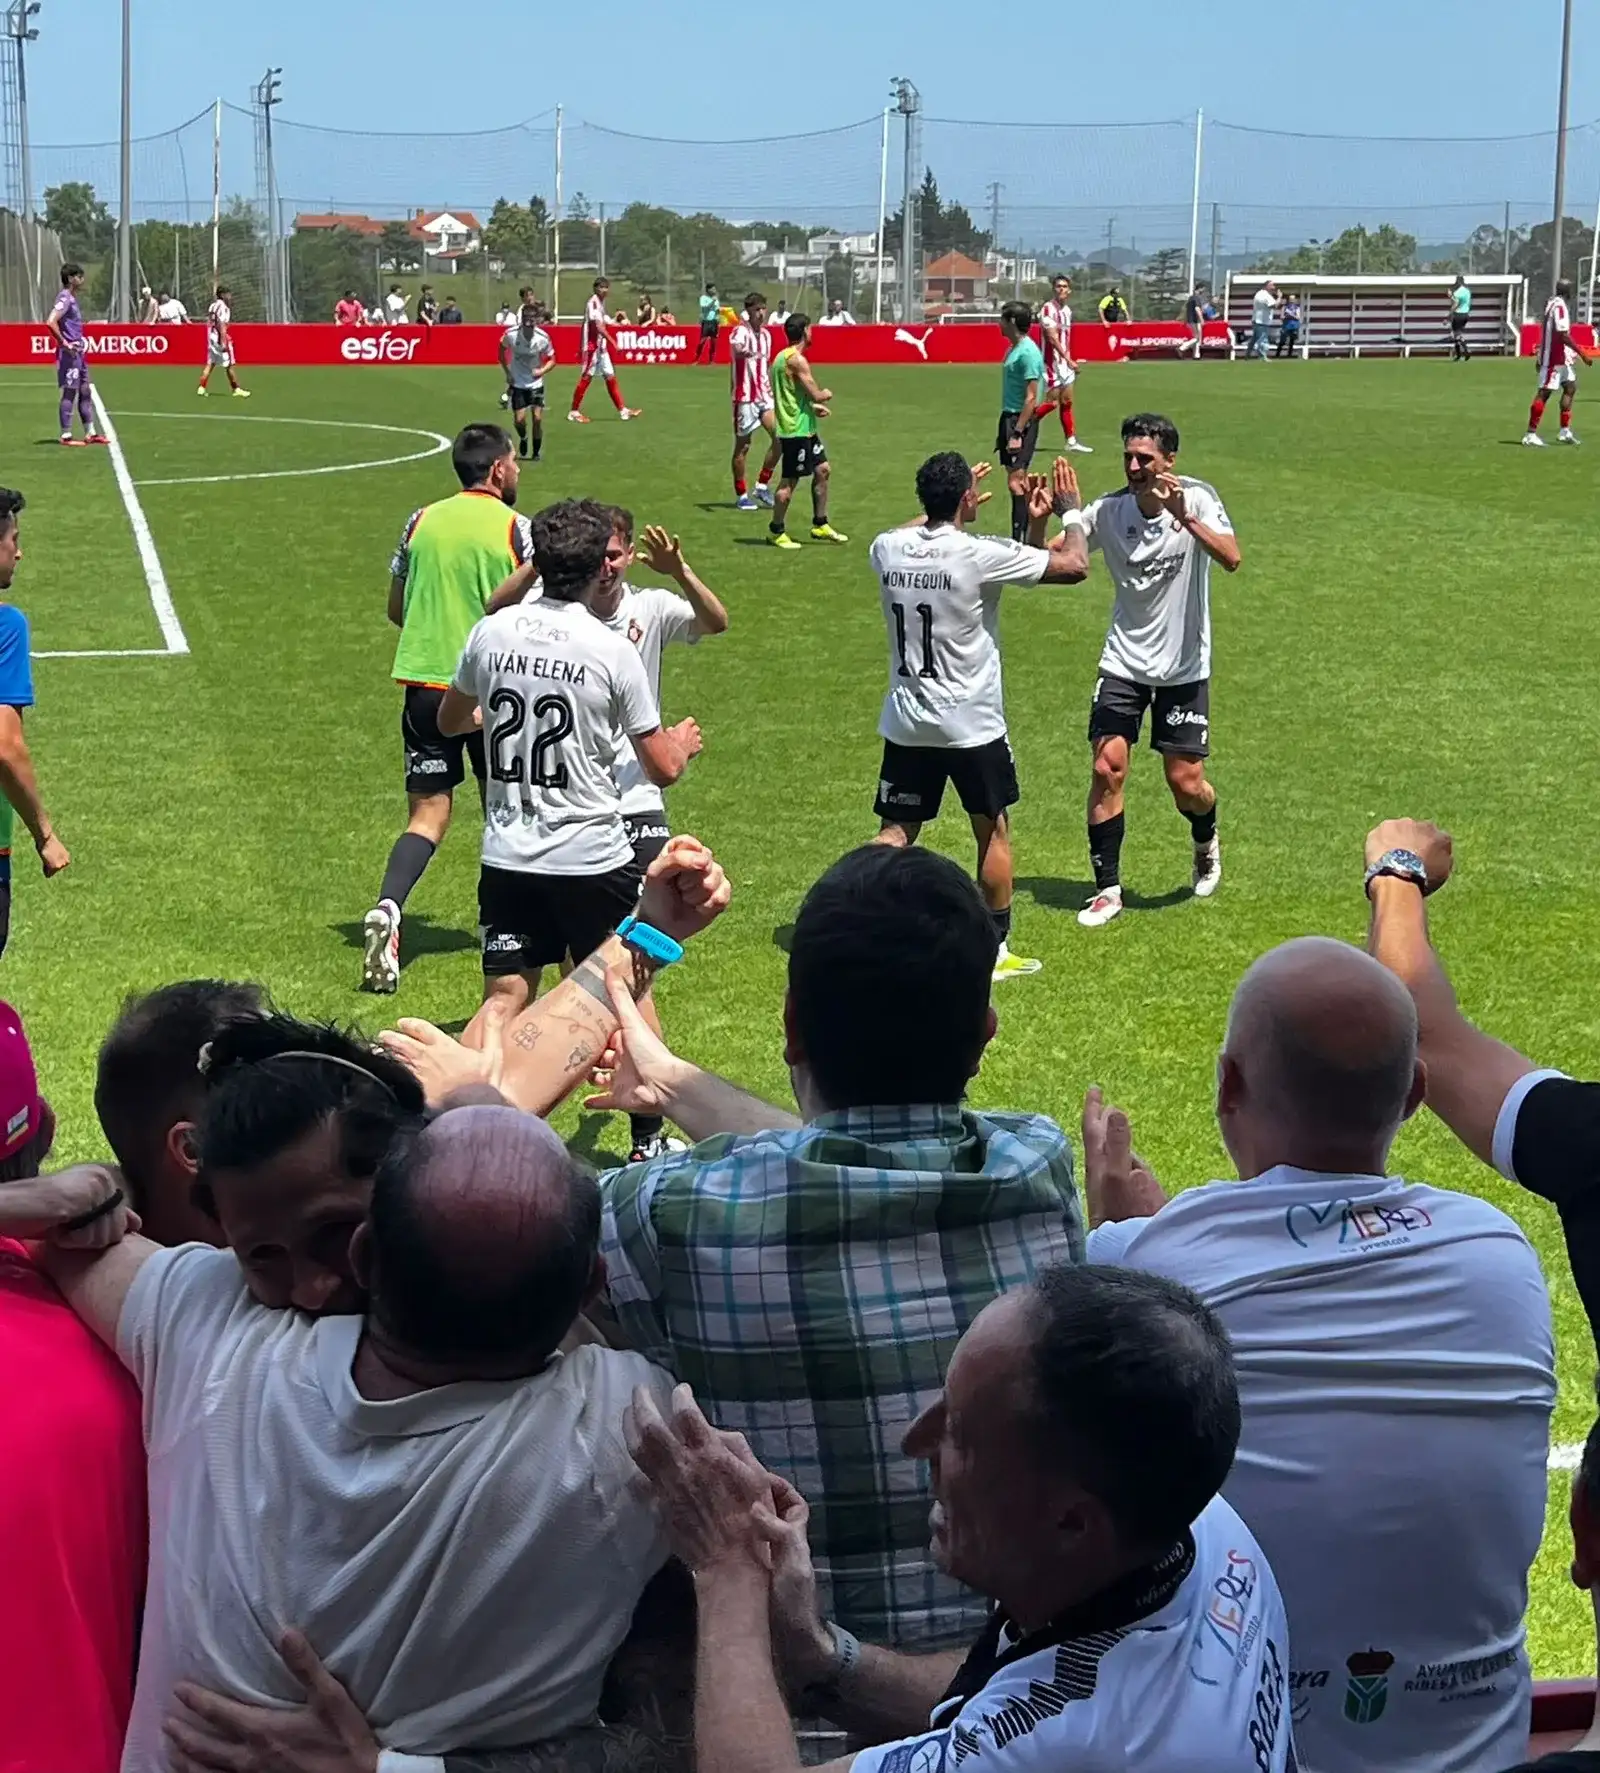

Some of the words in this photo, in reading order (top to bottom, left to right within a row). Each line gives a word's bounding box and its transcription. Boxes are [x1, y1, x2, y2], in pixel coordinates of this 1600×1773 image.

[31, 335, 57, 354] EL
[76, 335, 169, 355] OMERCIO
[341, 331, 420, 361] esfer
[616, 330, 687, 351] Mahou
[1120, 337, 1140, 346] Real
[882, 569, 952, 591] MONTEQUÍN
[891, 603, 938, 678] 11
[488, 649, 528, 675] IVÁN
[533, 656, 586, 686] ELENA
[488, 687, 573, 788] 22
